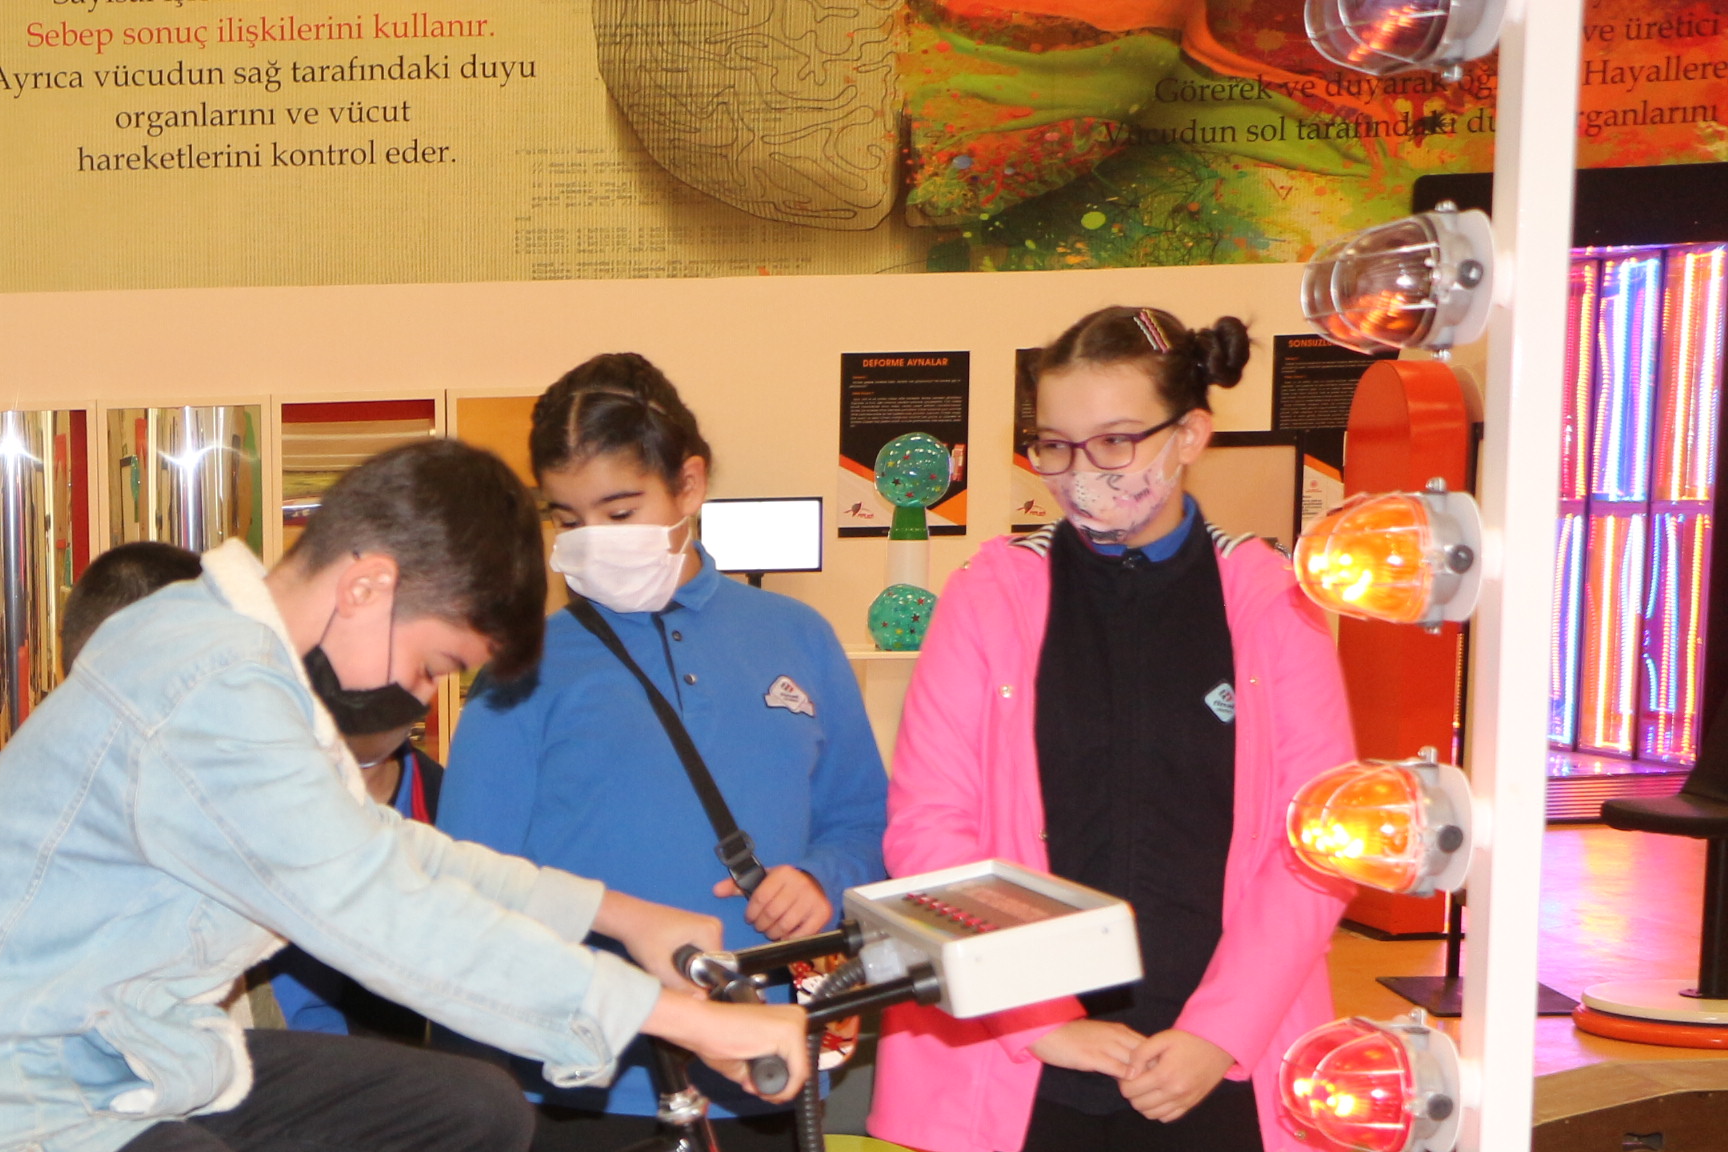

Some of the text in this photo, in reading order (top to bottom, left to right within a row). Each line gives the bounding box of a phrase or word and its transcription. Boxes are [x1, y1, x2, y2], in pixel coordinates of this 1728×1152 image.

[26, 12, 496, 55] Sebep sonuç ilişkilerini kullanır.
[1625, 10, 1721, 41] üretici
[94, 59, 225, 89] vücudun
[233, 59, 282, 93] sağ
[291, 54, 450, 85] tarafındaki
[460, 53, 537, 88] duyu
[1154, 74, 1272, 103] Görerek
[1282, 79, 1316, 99] ve
[1324, 71, 1449, 105] duyarak
[115, 100, 411, 138] organlarını ve vücut
[1102, 118, 1237, 146] Vücudun
[1245, 115, 1286, 142] sol
[77, 137, 456, 172] hareketlerini kontrol eder.
[862, 357, 949, 368] DEFORME AYNALAR
